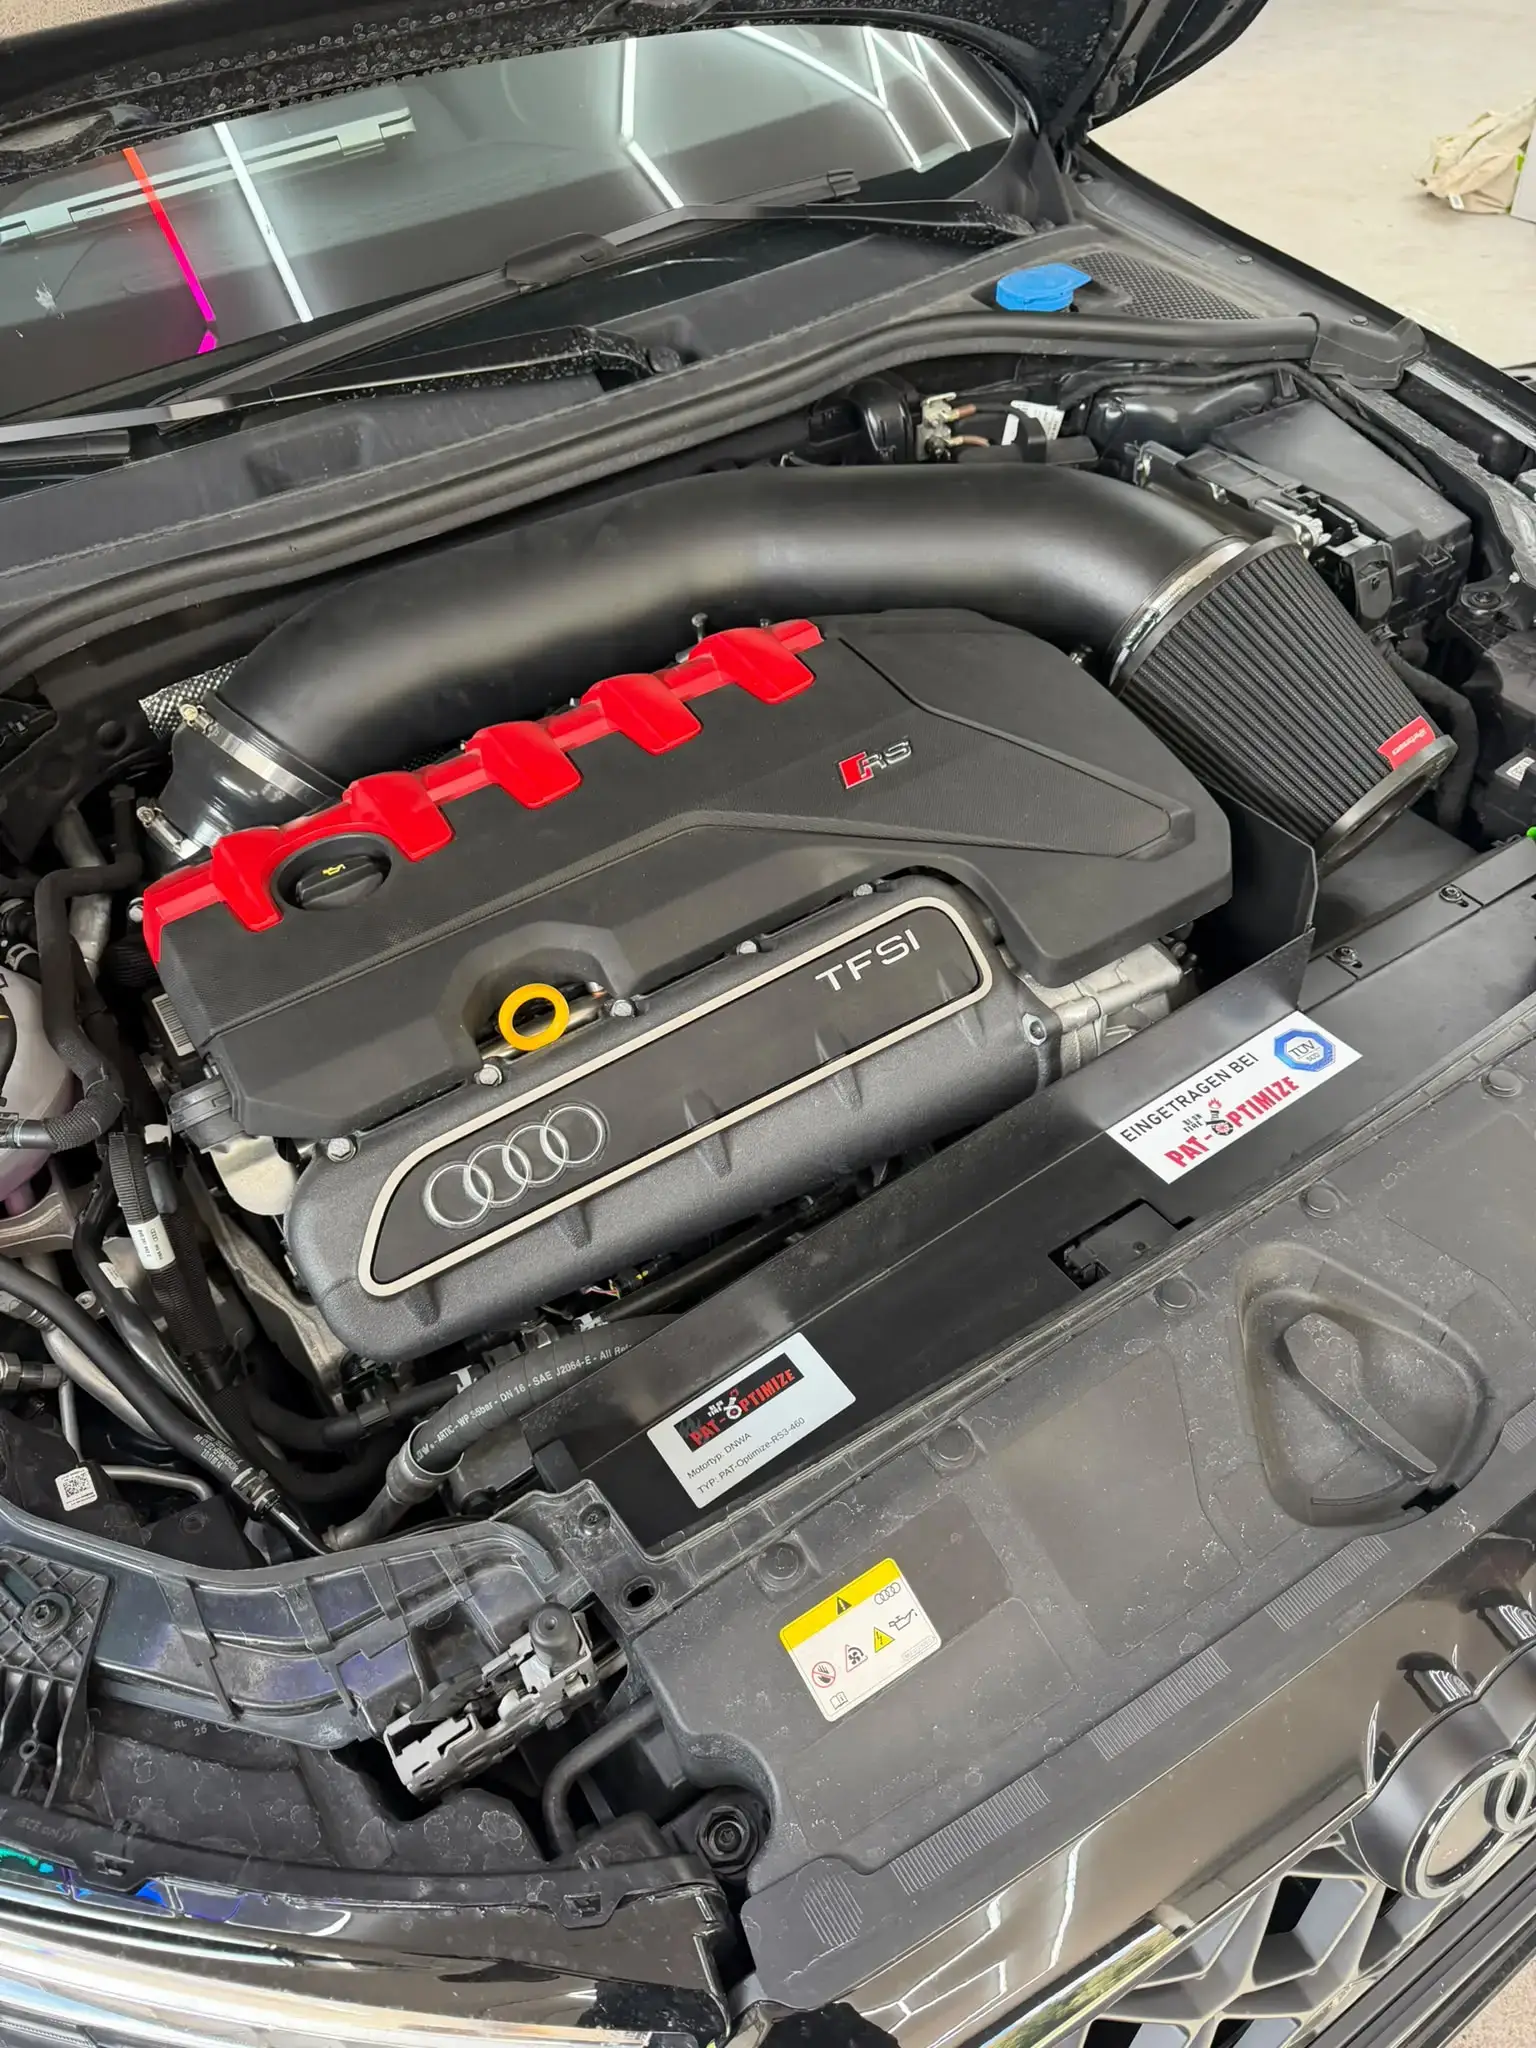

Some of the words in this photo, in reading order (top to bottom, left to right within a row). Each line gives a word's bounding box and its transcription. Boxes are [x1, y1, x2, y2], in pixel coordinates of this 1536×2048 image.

[857, 741, 912, 778] RS
[815, 929, 920, 991] TFSI
[1120, 1068, 1233, 1142] EINGETRAGEN
[1228, 1052, 1259, 1074] BEI
[456, 1414, 470, 1427] WP
[499, 1391, 514, 1401] DN
[515, 1383, 526, 1394] 16
[532, 1371, 553, 1387] SAE
[556, 1355, 593, 1377] J2064-E
[599, 1349, 612, 1361] All
[687, 1452, 725, 1480] Motortyp:
[724, 1432, 752, 1455] DNWA
[697, 1477, 720, 1494] TYP:
[719, 1417, 805, 1480] PAT-Optimize-RS3-460
